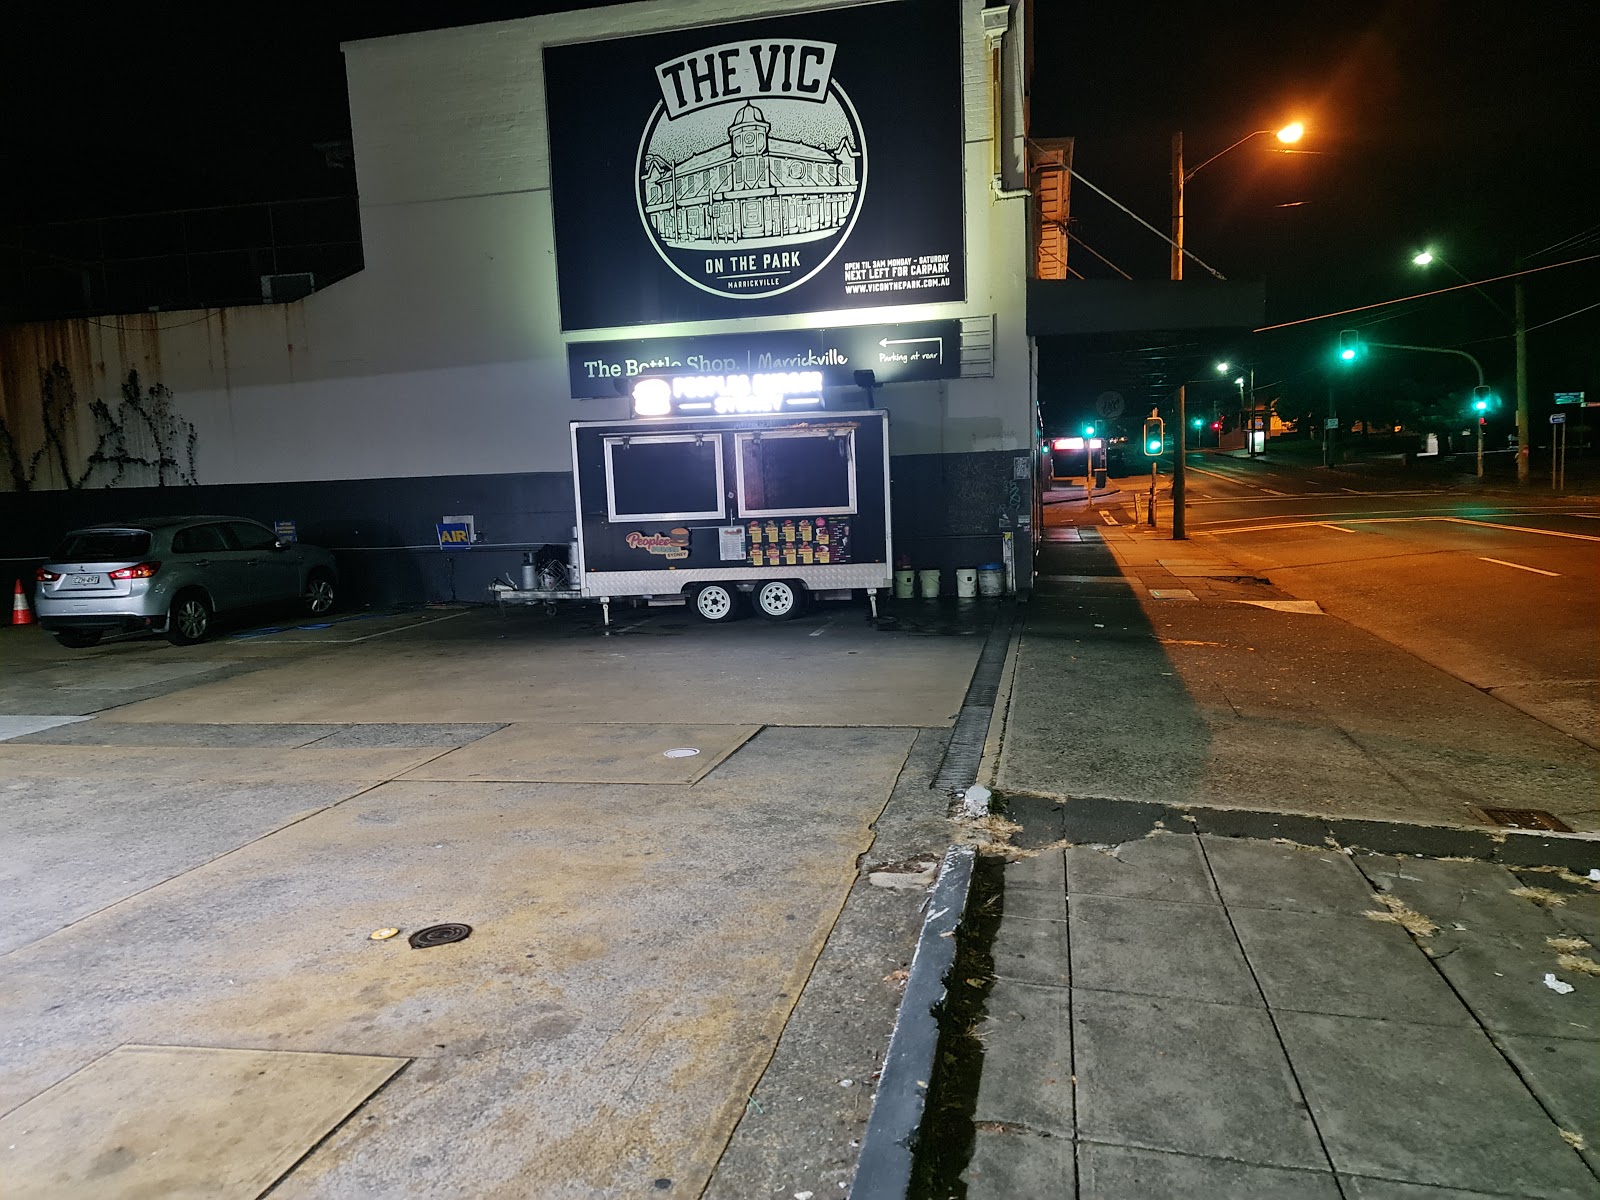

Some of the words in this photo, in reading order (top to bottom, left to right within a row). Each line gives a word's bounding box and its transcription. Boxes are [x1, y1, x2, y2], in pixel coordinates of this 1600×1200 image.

[661, 48, 742, 109] THE
[749, 44, 825, 93] VIC
[705, 258, 724, 274] ON
[730, 255, 757, 272] THE
[763, 251, 801, 269] PARK
[844, 262, 860, 271] OPEN
[861, 261, 871, 269] TIL
[887, 257, 912, 267] MONDAY
[918, 254, 950, 264] SATURDAY
[844, 269, 866, 282] NEXT
[869, 267, 890, 280] LEFT
[891, 266, 908, 278] FOR
[911, 262, 950, 276] CARPARK
[727, 278, 780, 289] MARRICKVILLE
[844, 277, 951, 295] WWW.VICONTHEPARK.COM.AU
[584, 359, 622, 378] The
[758, 348, 849, 370] Marrickville
[878, 352, 908, 364] Parking
[910, 351, 921, 360] at
[921, 351, 939, 360] rear
[441, 530, 468, 543] AIR
